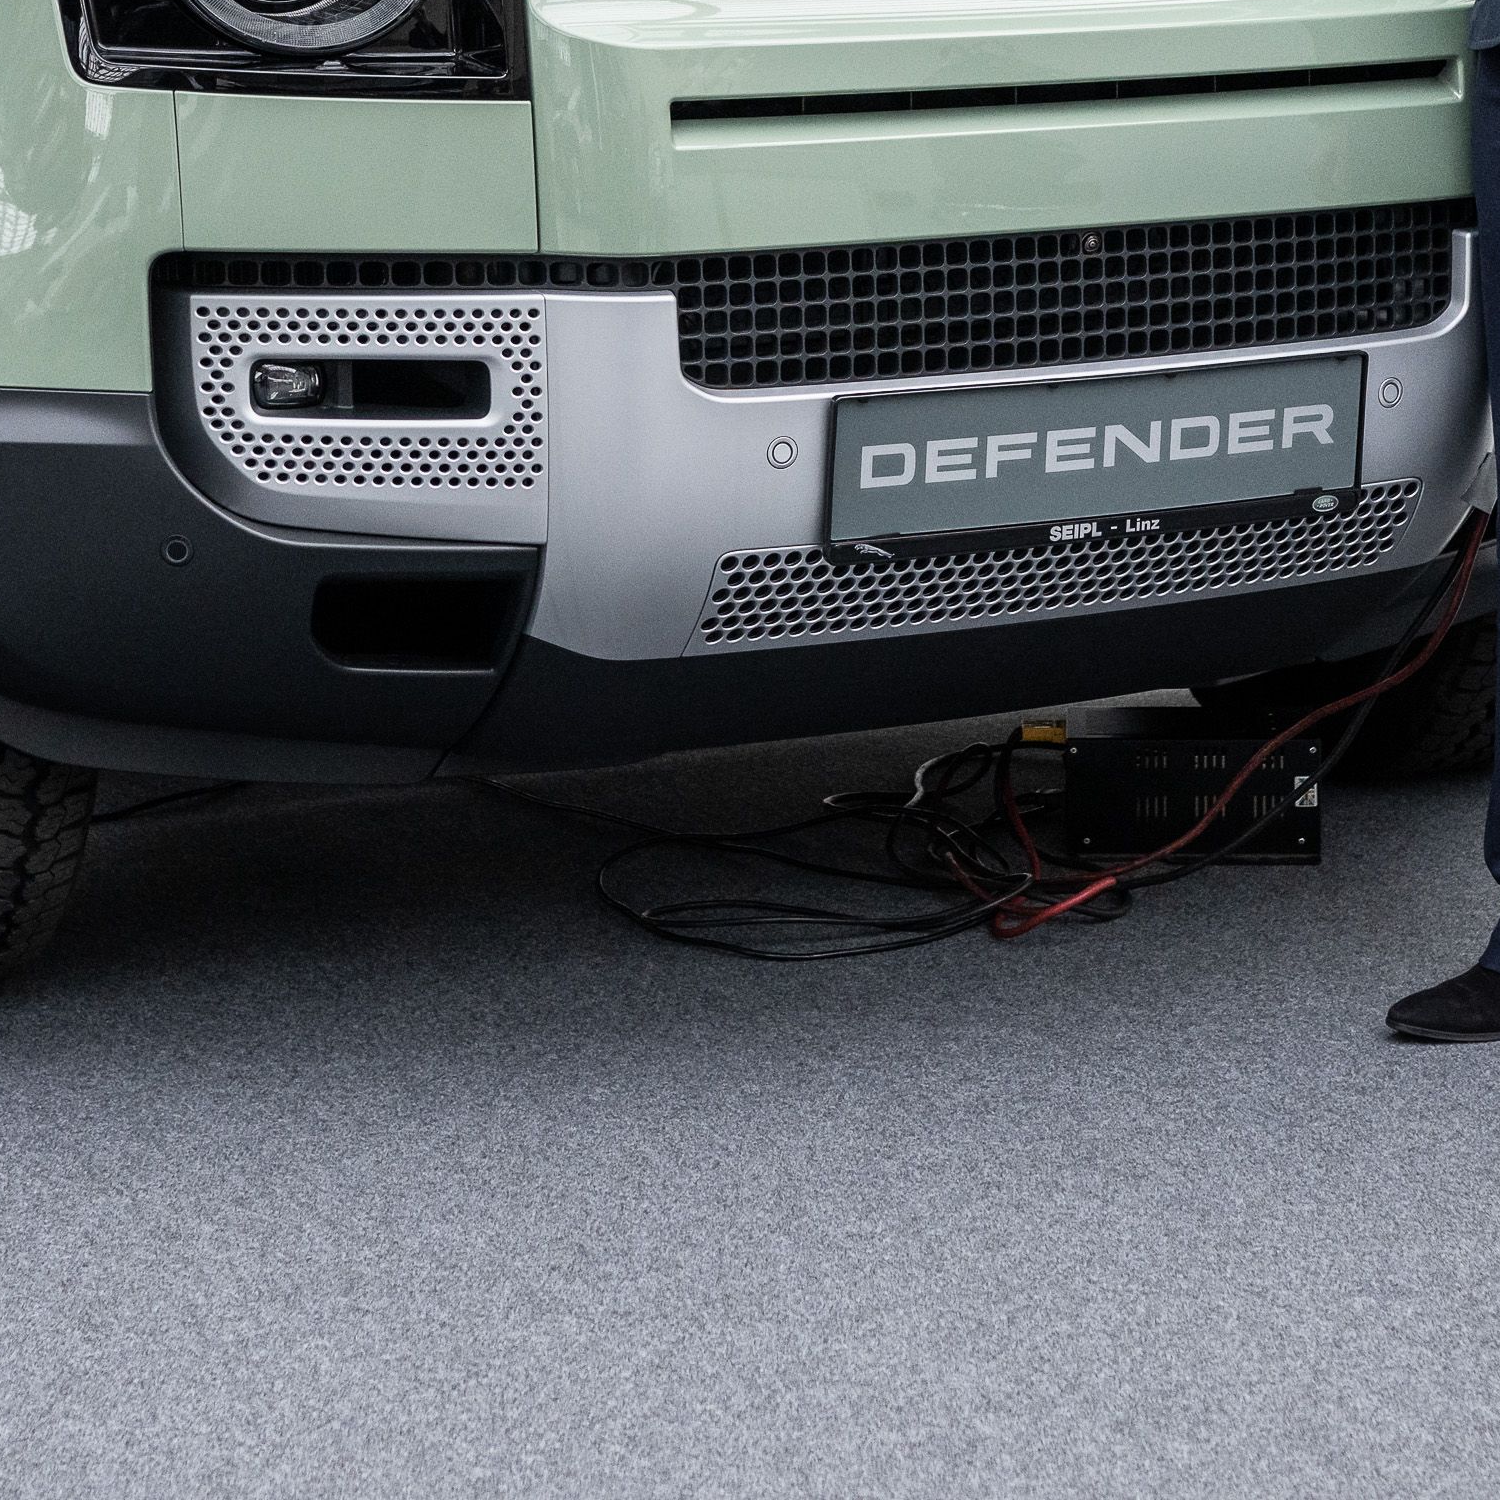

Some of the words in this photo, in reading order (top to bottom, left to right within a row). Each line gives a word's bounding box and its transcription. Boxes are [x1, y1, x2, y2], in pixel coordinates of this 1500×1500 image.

[859, 403, 1335, 490] DEFENDER
[1049, 521, 1102, 542] SEIPL
[1125, 518, 1160, 533] Linz
